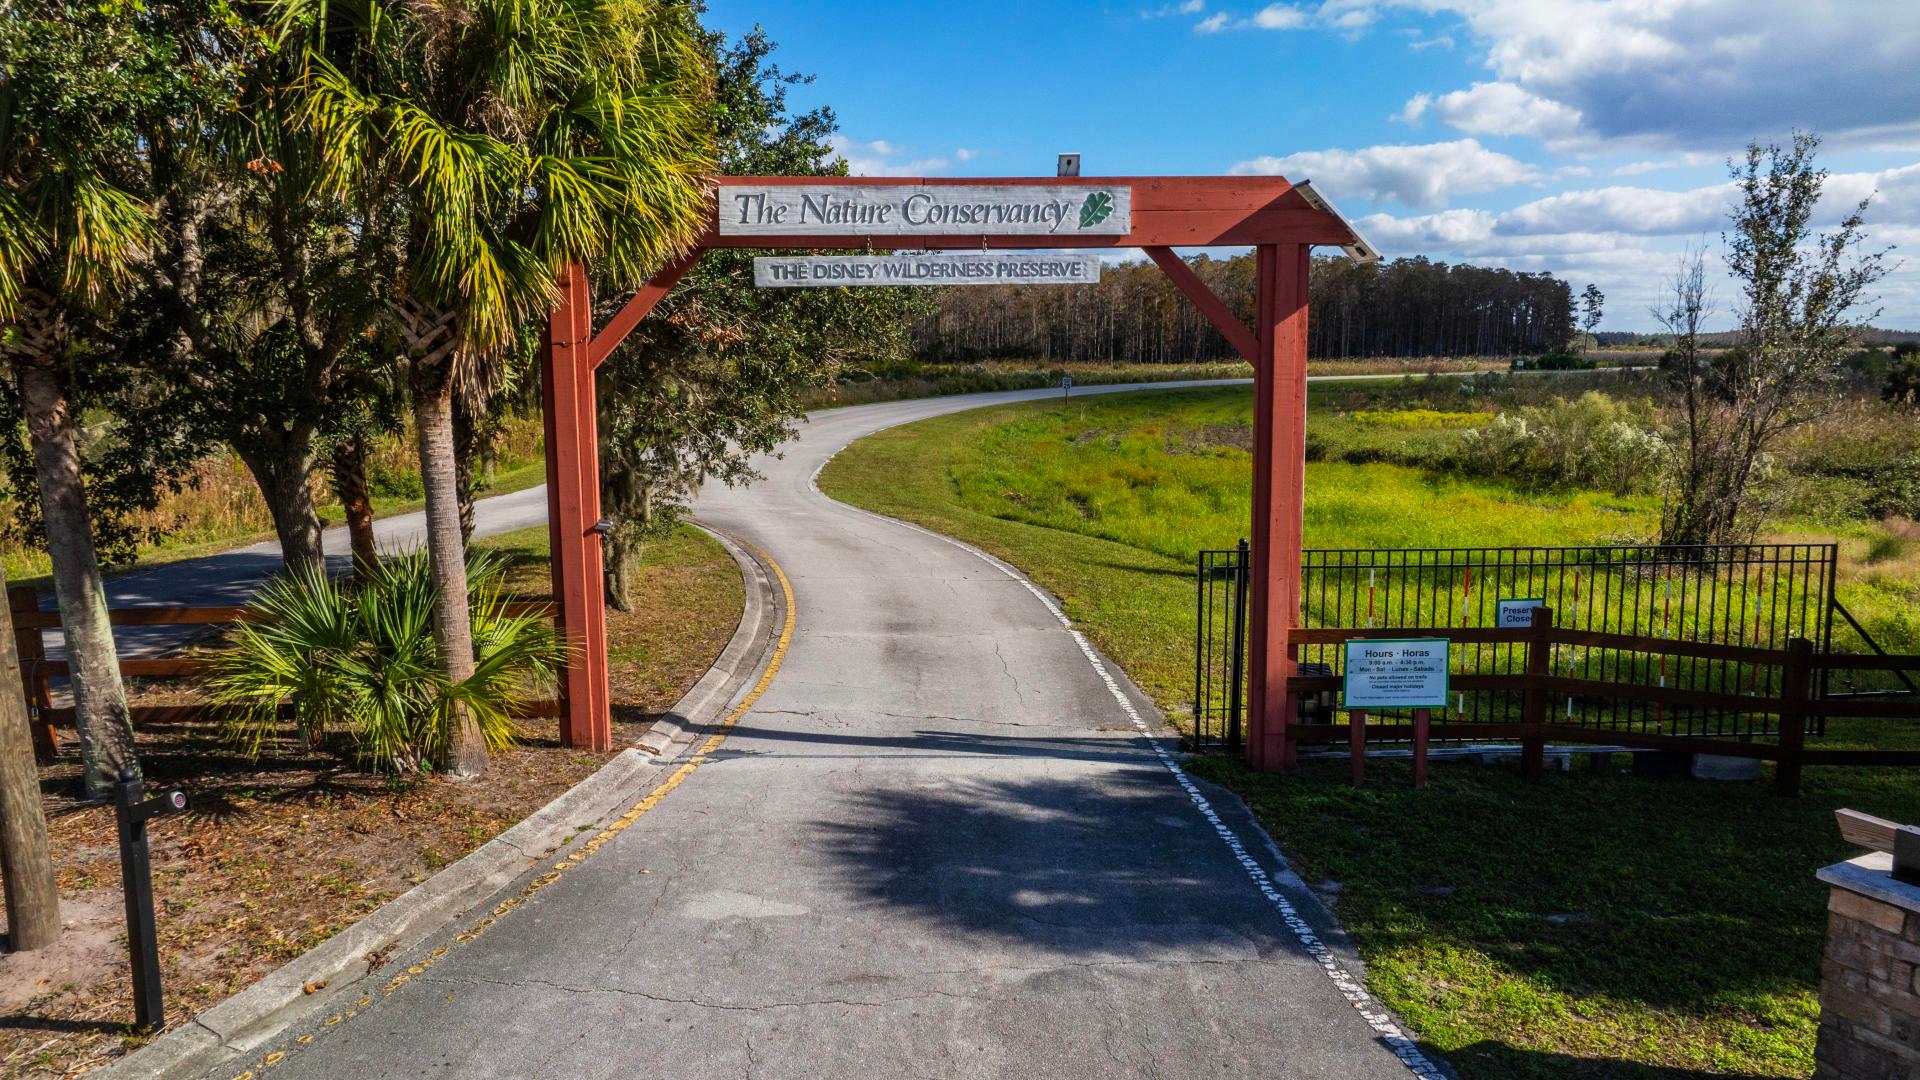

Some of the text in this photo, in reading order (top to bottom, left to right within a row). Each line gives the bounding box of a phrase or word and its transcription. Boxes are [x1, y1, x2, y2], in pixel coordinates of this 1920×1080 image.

[735, 192, 1070, 233] The Nature Conservancy
[769, 262, 1081, 280] THE DISNEY WILDERNESS PRESERVE
[1503, 606, 1533, 614] Preserv
[1365, 649, 1430, 657] Hours Horas
